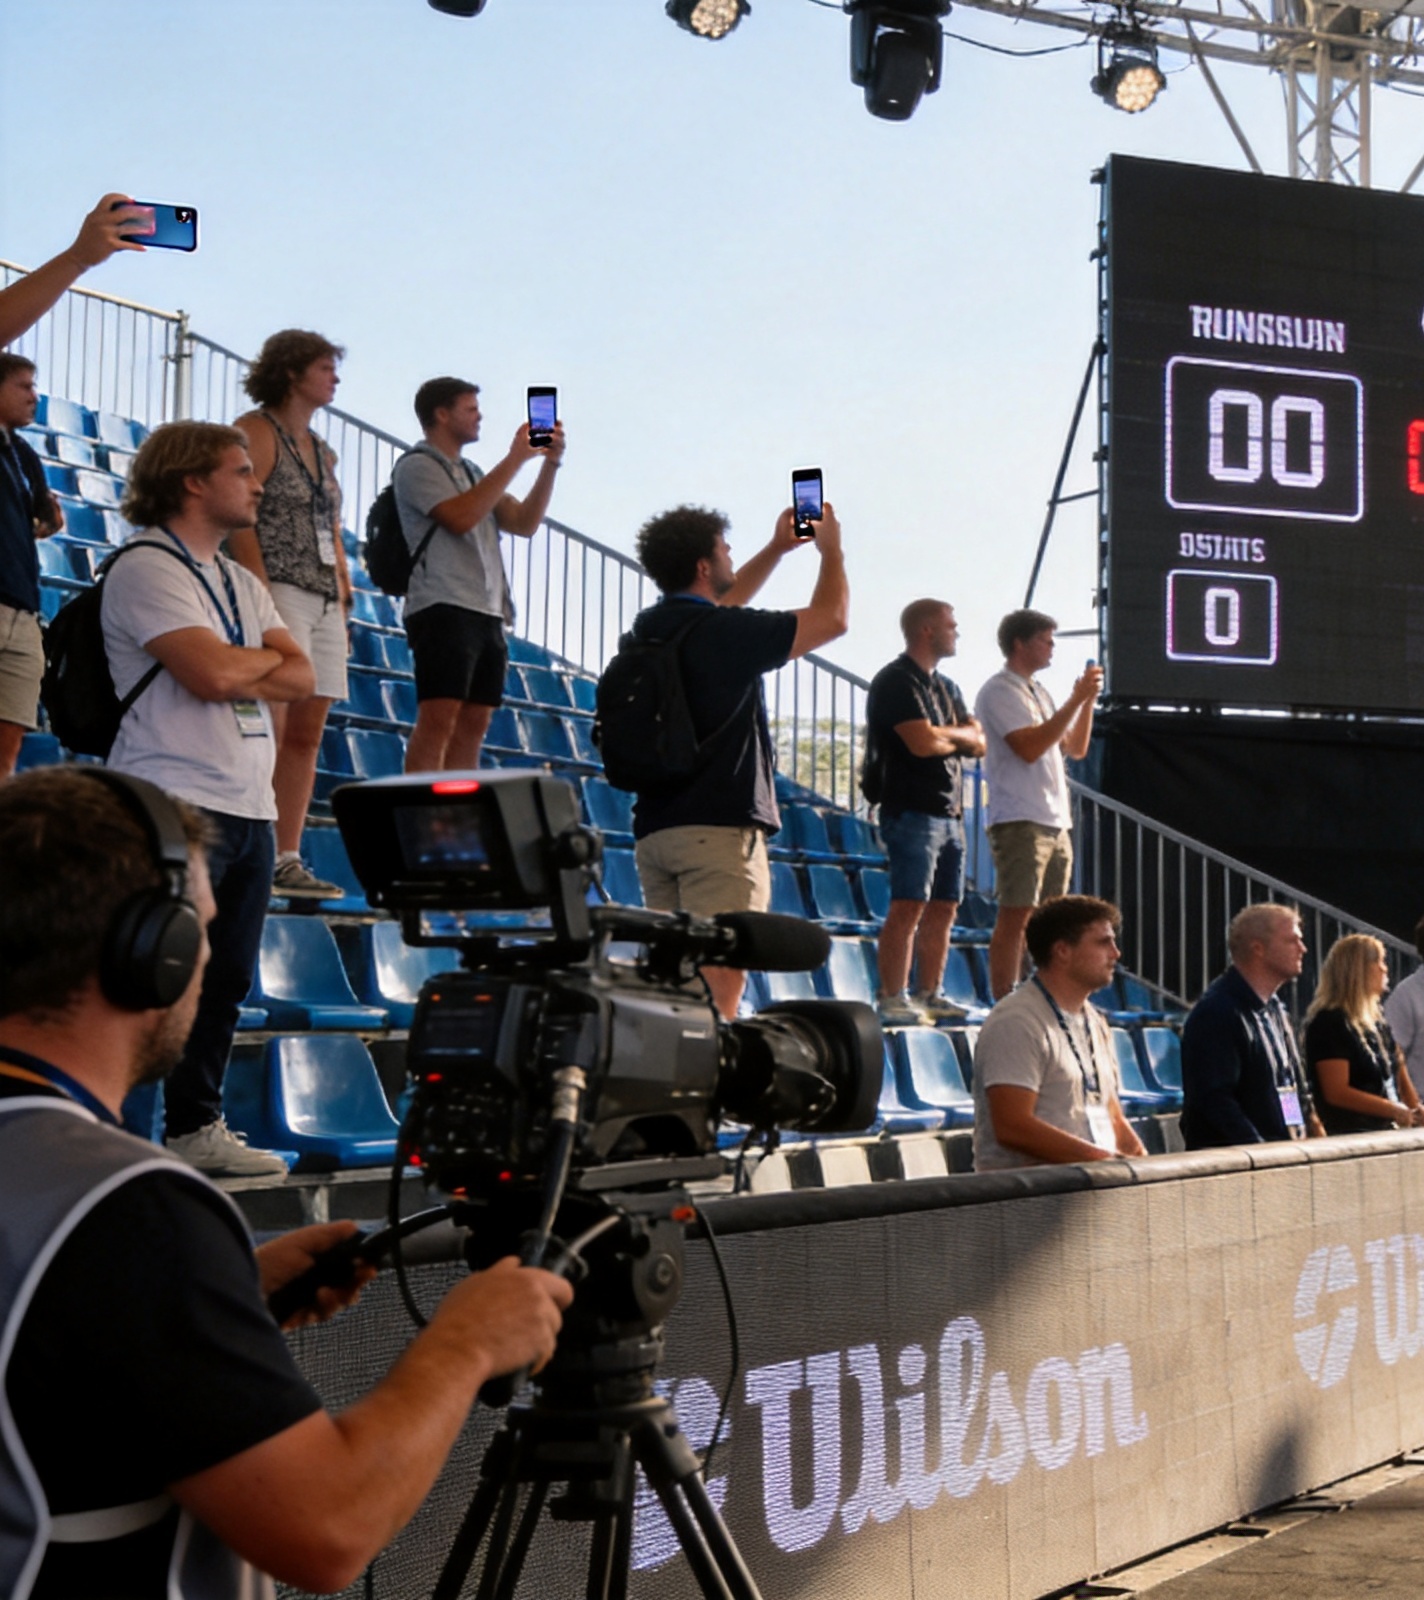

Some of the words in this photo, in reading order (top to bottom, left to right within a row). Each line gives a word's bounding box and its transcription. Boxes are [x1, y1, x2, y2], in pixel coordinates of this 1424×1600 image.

[1208, 389, 1325, 488] 00
[1204, 587, 1240, 646] 0
[745, 1316, 1148, 1553] Wilson
